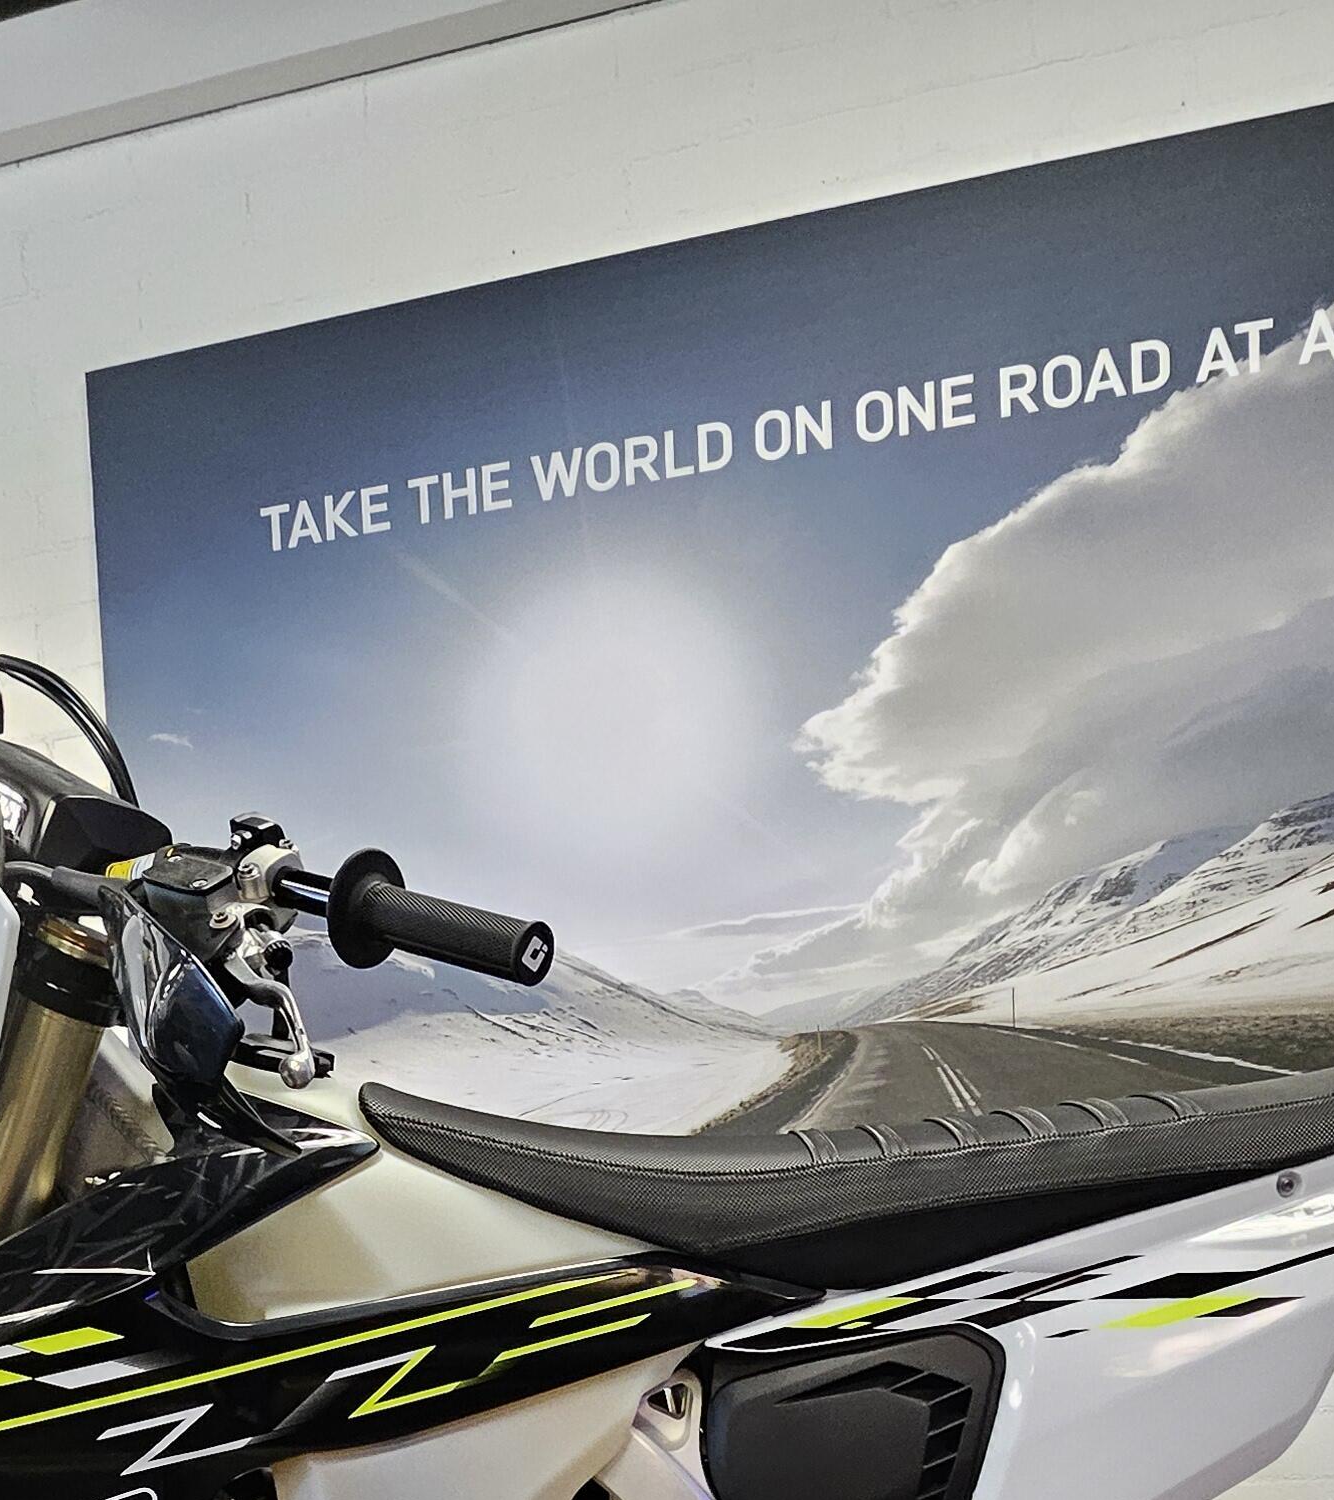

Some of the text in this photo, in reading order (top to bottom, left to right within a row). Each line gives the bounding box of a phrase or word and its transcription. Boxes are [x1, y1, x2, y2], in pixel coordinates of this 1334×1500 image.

[260, 484, 391, 552] TAKE
[408, 461, 512, 524] THE
[530, 421, 733, 501] WORLD
[754, 400, 833, 461] ON
[855, 374, 975, 442] ONE
[999, 338, 1169, 418] ROAD
[1196, 317, 1274, 383] AT
